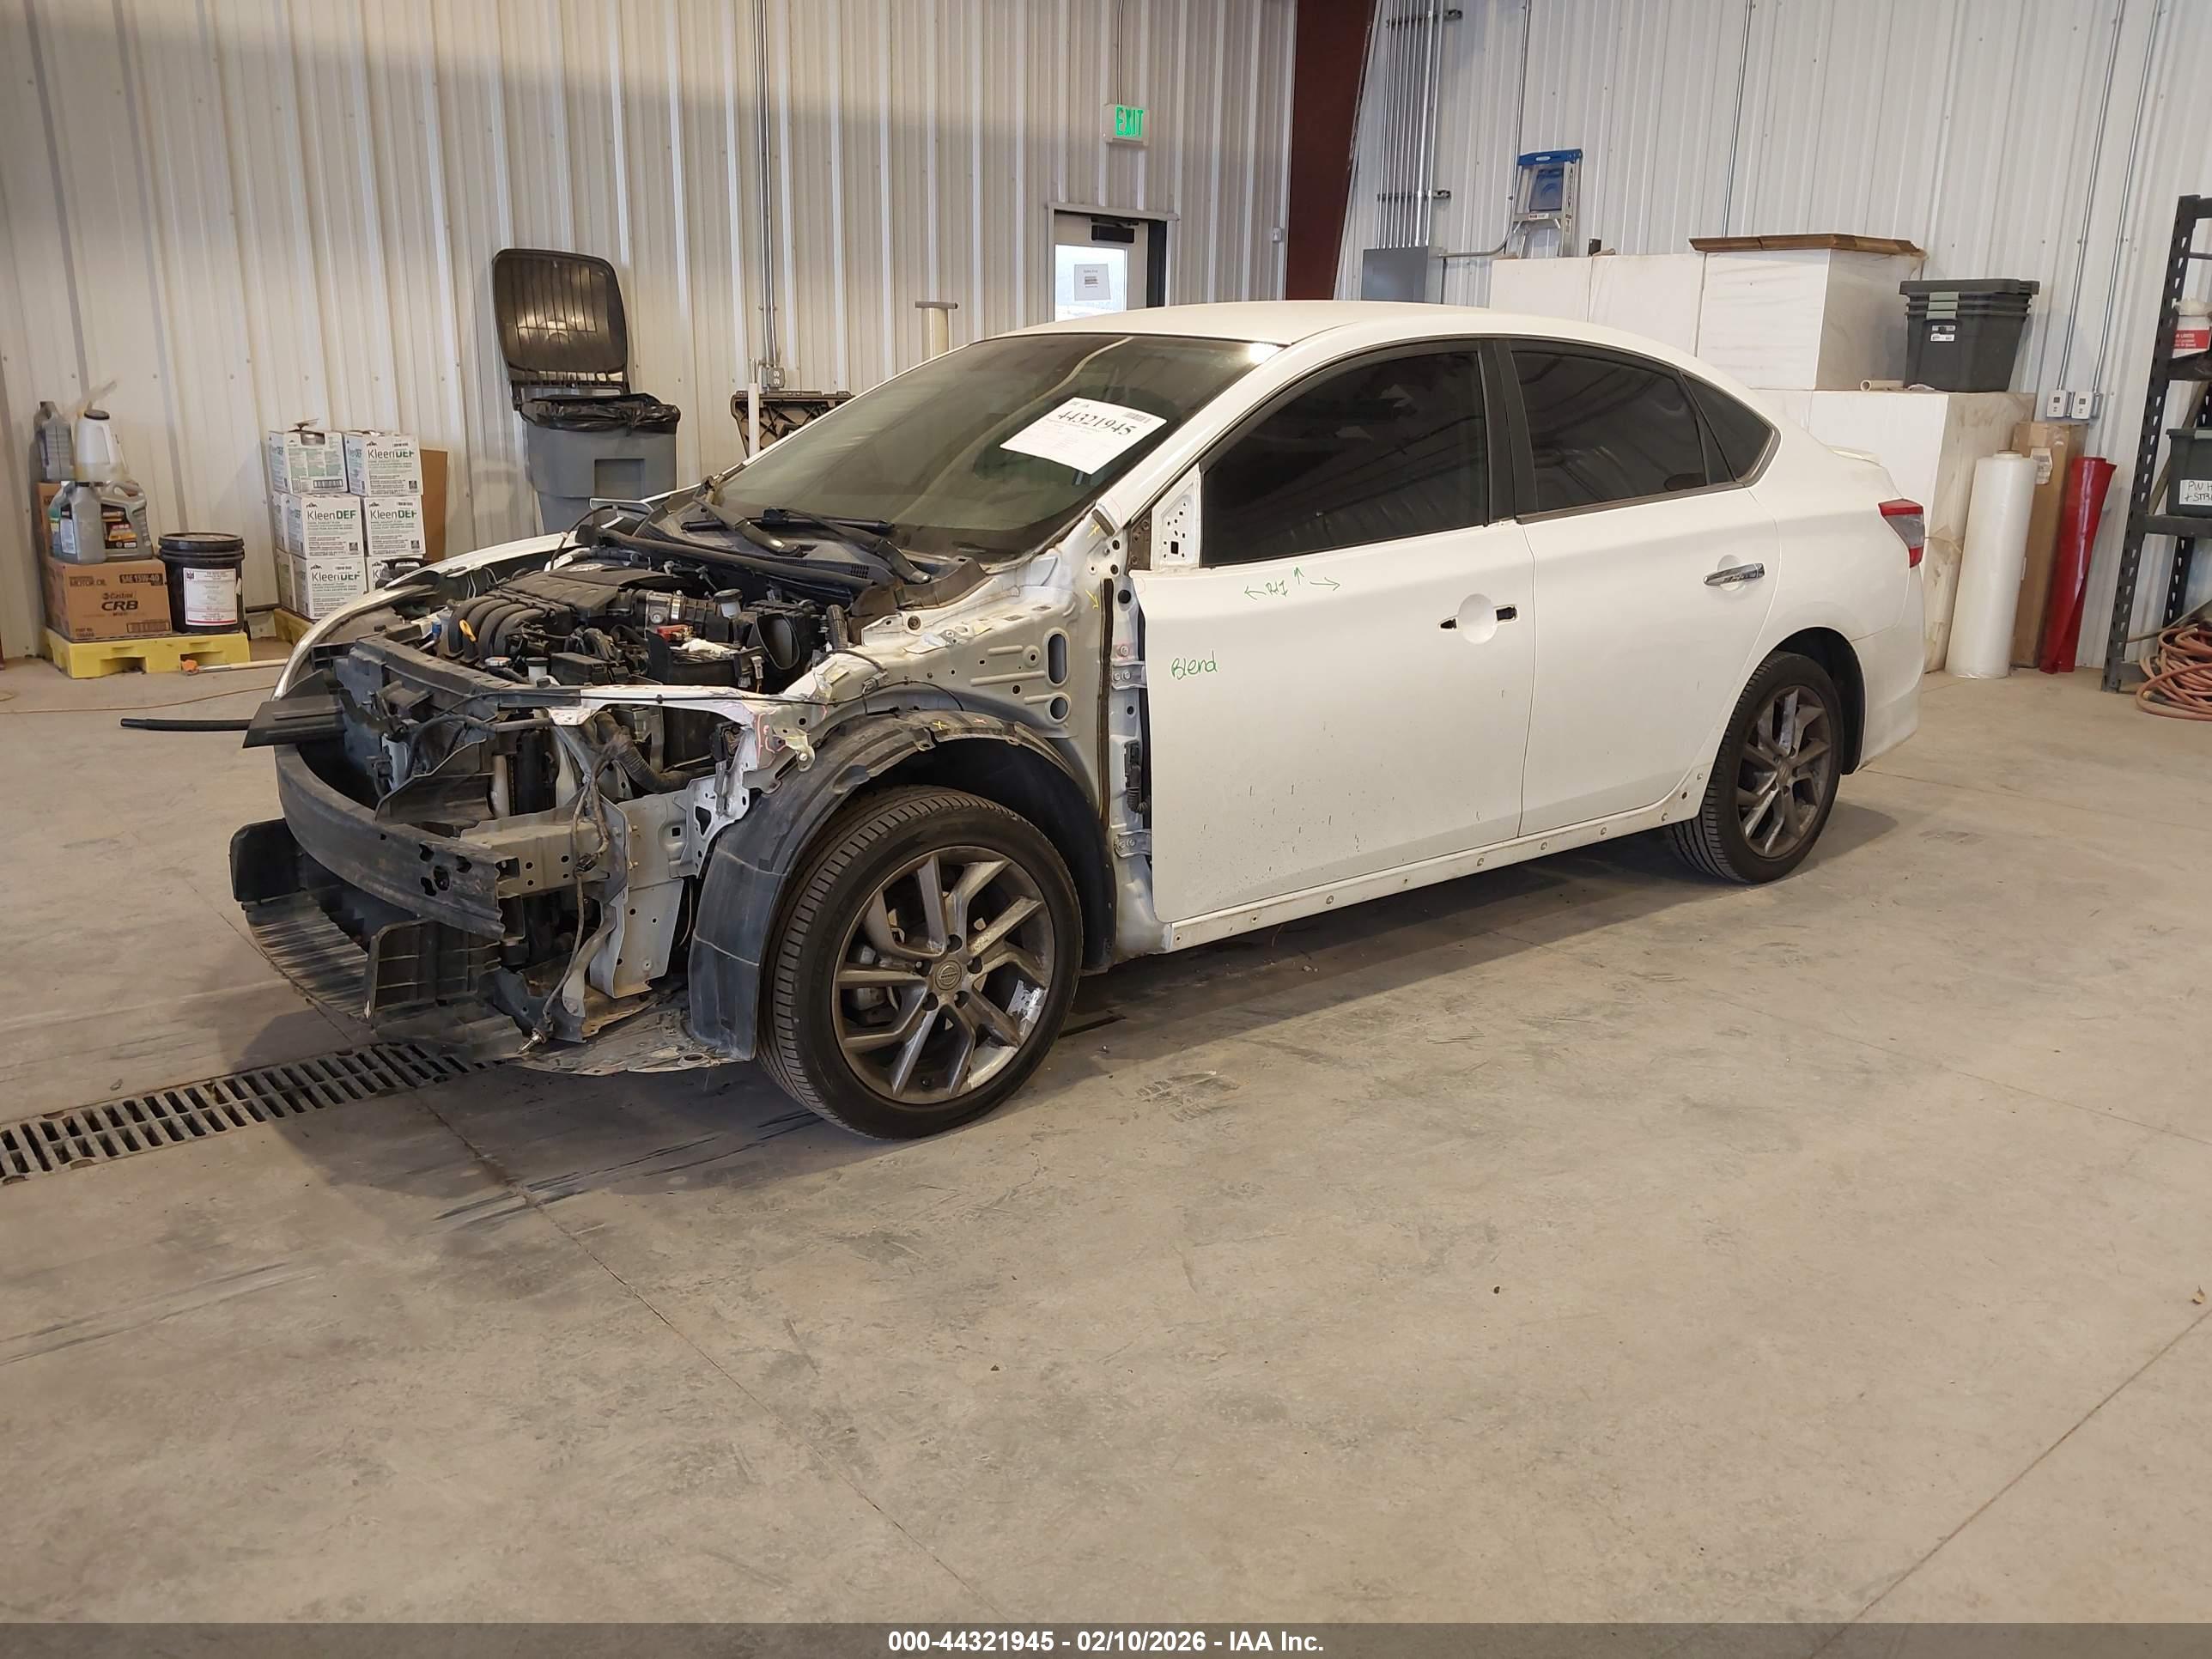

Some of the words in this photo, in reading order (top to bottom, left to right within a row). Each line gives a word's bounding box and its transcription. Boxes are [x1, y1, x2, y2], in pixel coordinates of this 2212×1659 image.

[1115, 106, 1144, 138] EXIT
[1057, 410, 1137, 435] 44321945
[307, 510, 357, 520] KleenDEF
[370, 510, 417, 520] KleenDEF
[101, 600, 138, 611] CRB
[1170, 649, 1218, 680] Blend
